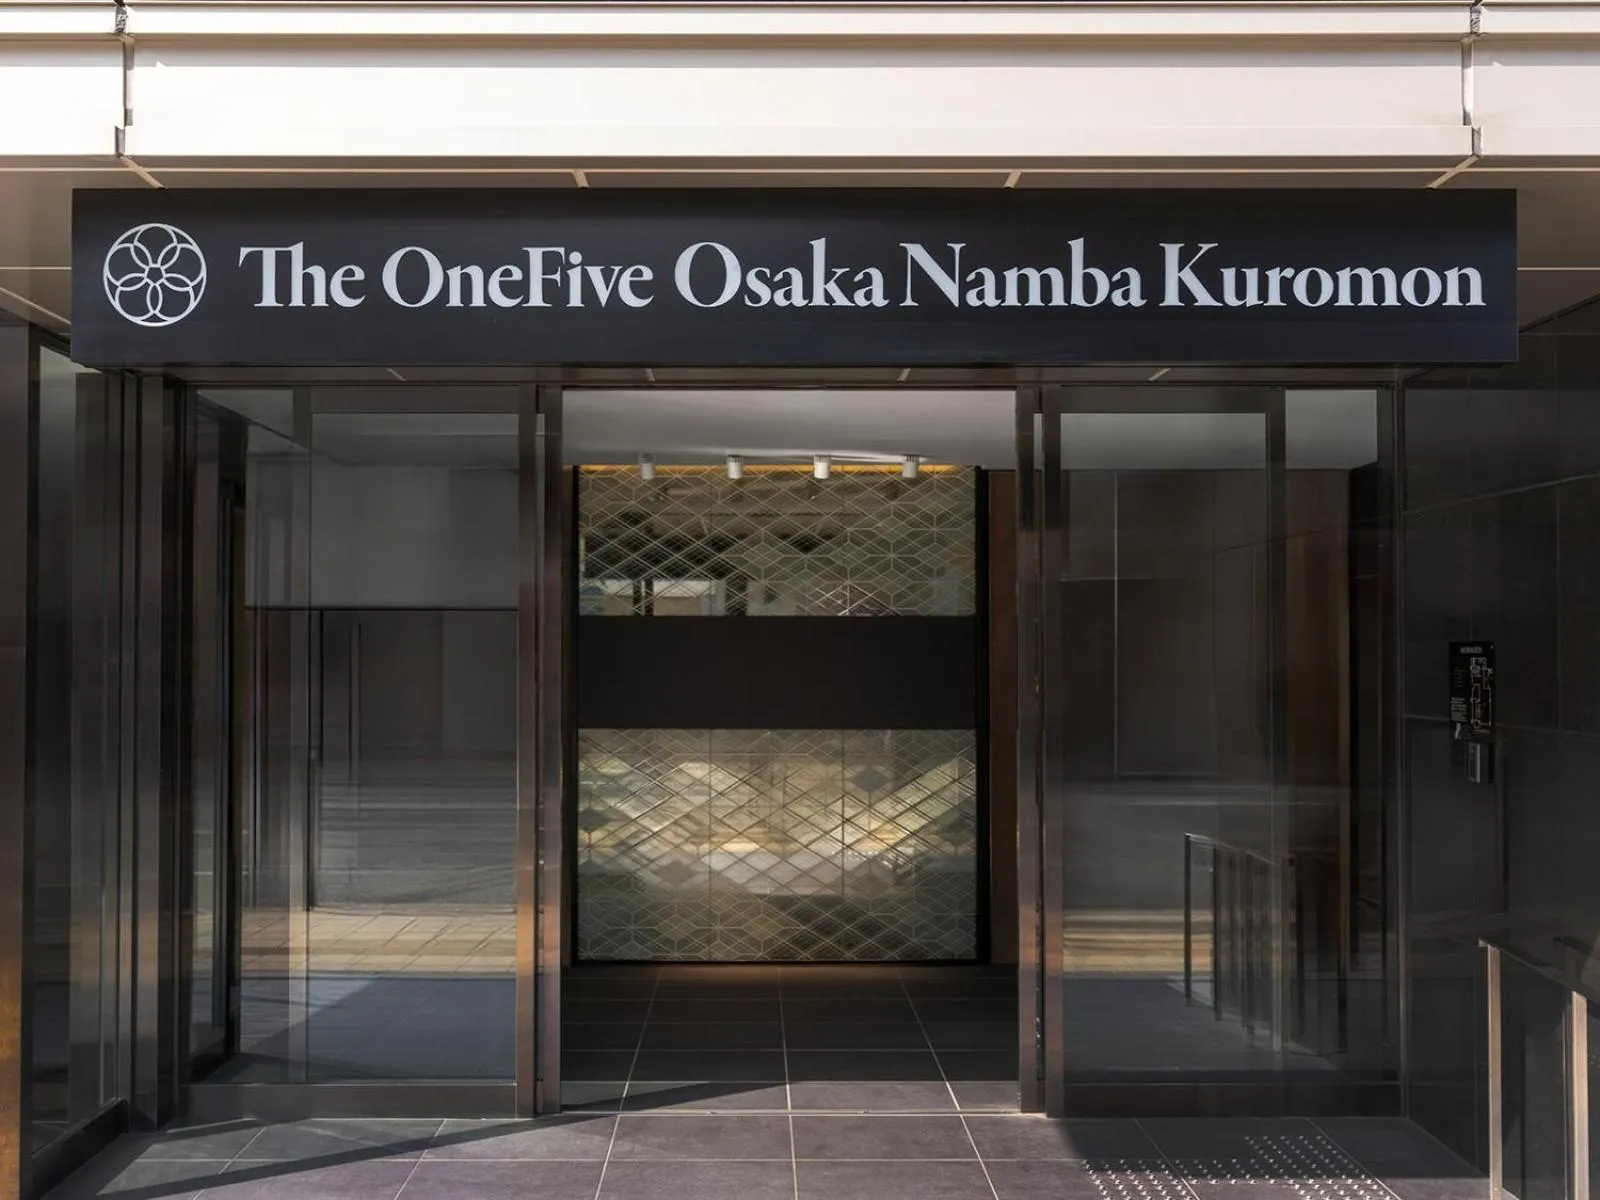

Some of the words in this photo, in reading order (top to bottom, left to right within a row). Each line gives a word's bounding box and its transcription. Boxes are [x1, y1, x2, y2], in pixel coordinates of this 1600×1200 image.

[238, 241, 366, 308] The
[381, 245, 655, 309] OneFive
[674, 237, 890, 309] Osaka
[899, 237, 1147, 309] Namba
[1158, 242, 1487, 309] Kuromon
